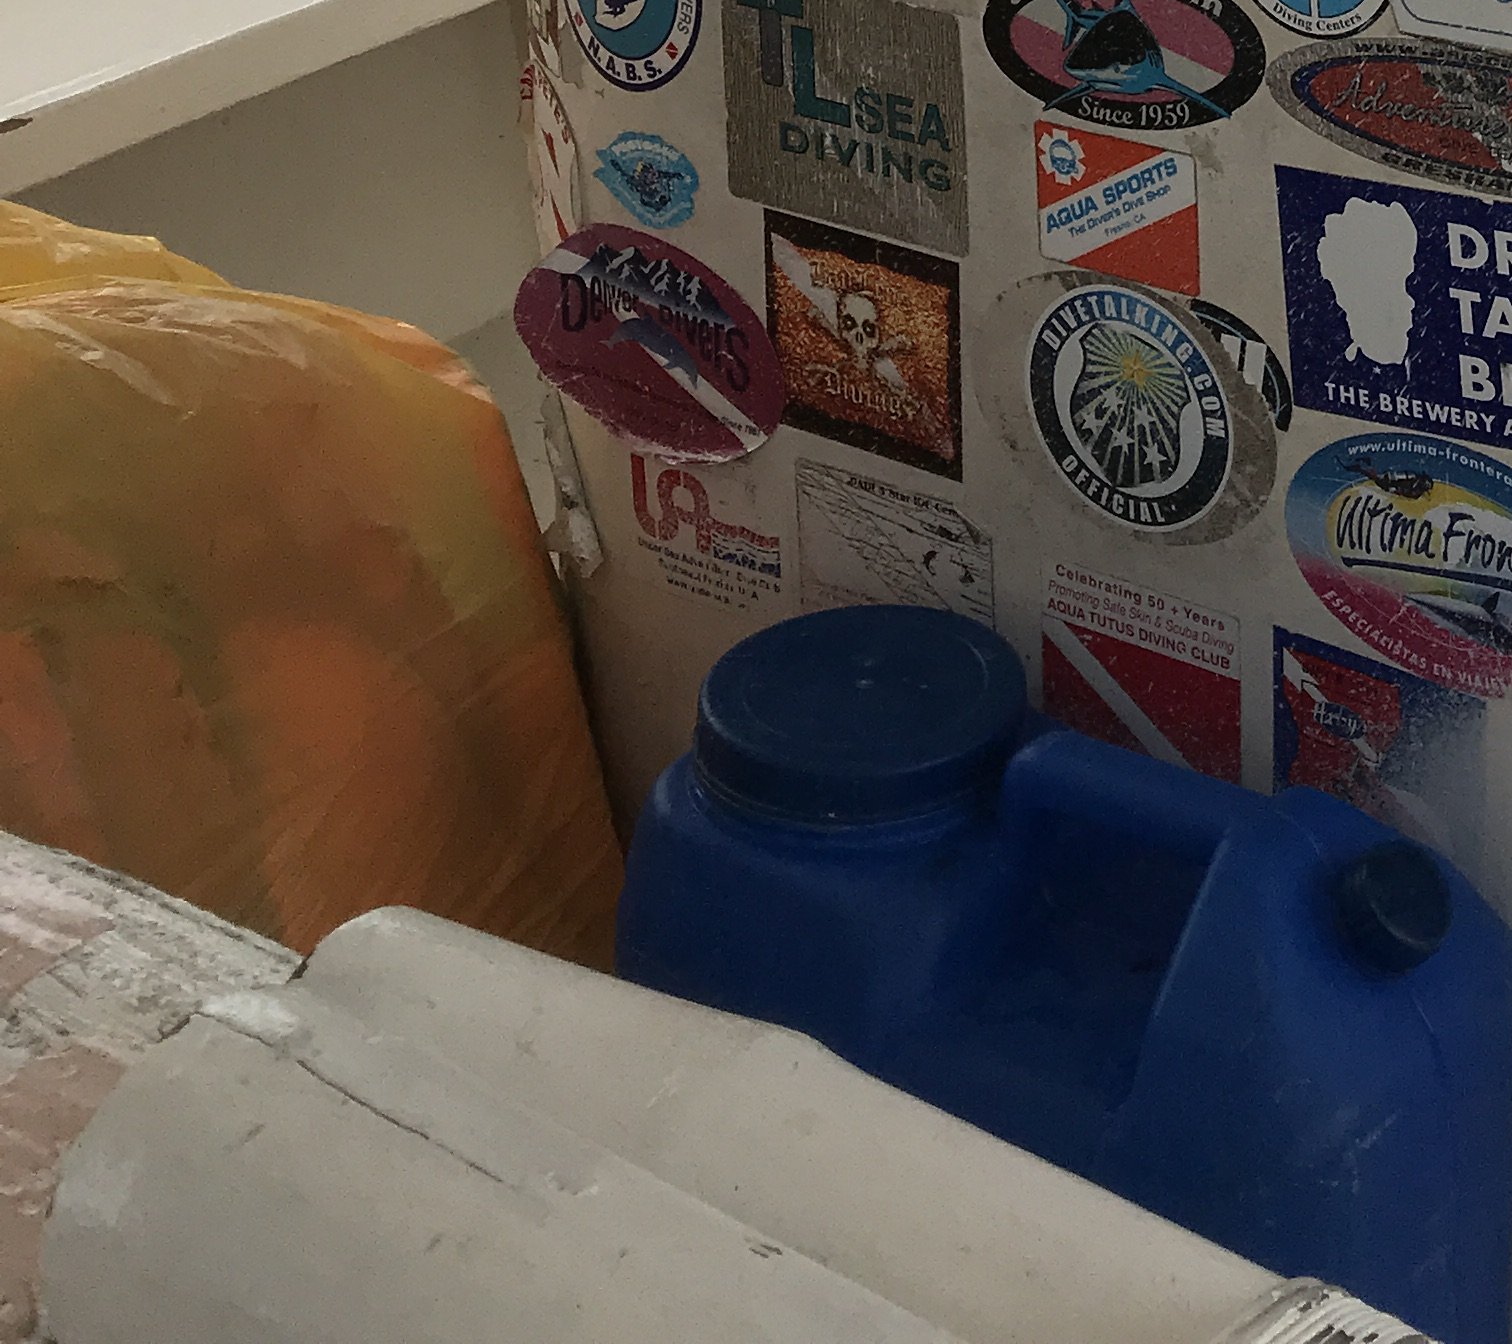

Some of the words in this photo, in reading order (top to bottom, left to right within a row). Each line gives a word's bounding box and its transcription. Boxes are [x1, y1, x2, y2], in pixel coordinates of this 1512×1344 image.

[1272, 2, 1313, 32] Diving
[1315, 12, 1363, 32] Centers
[853, 86, 952, 153] SEA
[1078, 95, 1133, 125] Since
[1138, 100, 1191, 126] 1959
[778, 120, 952, 192] DIVING
[1046, 195, 1099, 234] AQUA
[1102, 156, 1178, 206] SPORTS
[1041, 294, 1227, 439] DIVETALKING.COM
[1324, 381, 1370, 408] THE
[1378, 392, 1498, 435] BREWERY
[1061, 454, 1166, 523] OFFICIAL
[1335, 495, 1436, 559] Ultima
[1048, 579, 1100, 609] Promoting
[1102, 597, 1127, 615] Safe
[1165, 618, 1199, 641] Scuba
[1201, 630, 1235, 655] Diving
[1055, 563, 1143, 606] Celebrating
[1147, 594, 1165, 612] 50
[1183, 607, 1226, 632] Years
[1047, 597, 1086, 621] AQUA
[1090, 610, 1135, 637] TUTUS
[1138, 627, 1187, 654] DIVING
[1190, 645, 1231, 670] CLUB
